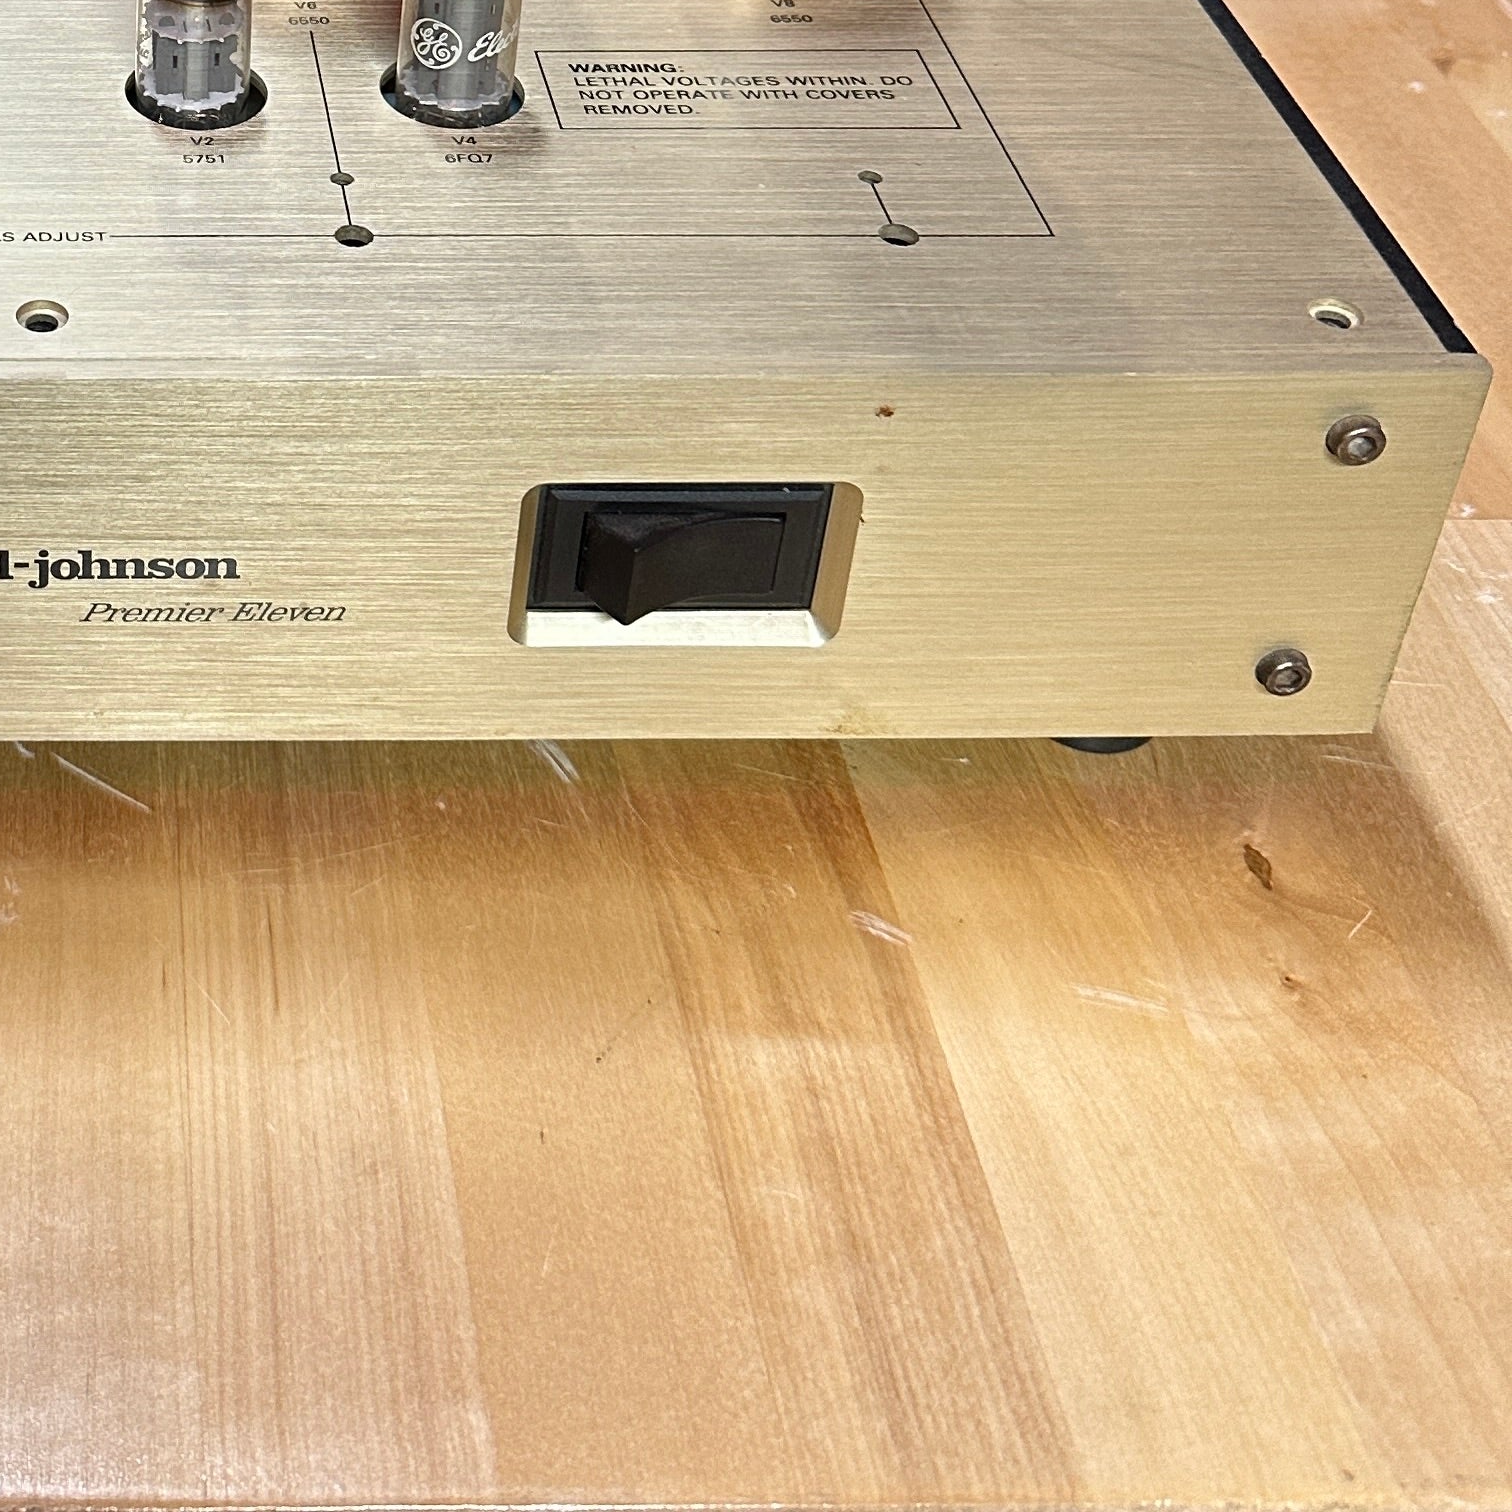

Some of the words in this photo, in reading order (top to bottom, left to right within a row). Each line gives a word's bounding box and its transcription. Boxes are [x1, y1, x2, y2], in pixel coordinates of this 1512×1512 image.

[770, 14, 813, 23] 6550
[567, 63, 685, 73] WARNING:
[573, 76, 657, 87] LETHAL
[661, 76, 781, 86] VOLTAGES
[784, 75, 875, 86] WITHIN.
[879, 75, 914, 86] DO
[579, 90, 624, 100] NOT
[633, 90, 735, 100] OPERATE
[740, 90, 799, 100] WITH
[805, 89, 896, 100] COVERS
[583, 104, 700, 115] REMOVED.
[189, 136, 215, 146] V2
[451, 136, 478, 145] V4
[182, 154, 226, 164] 5751
[445, 153, 493, 164] 6FQ7
[22, 231, 107, 242] ADJUST
[79, 602, 224, 623] Premier
[227, 602, 347, 622] Eleven
